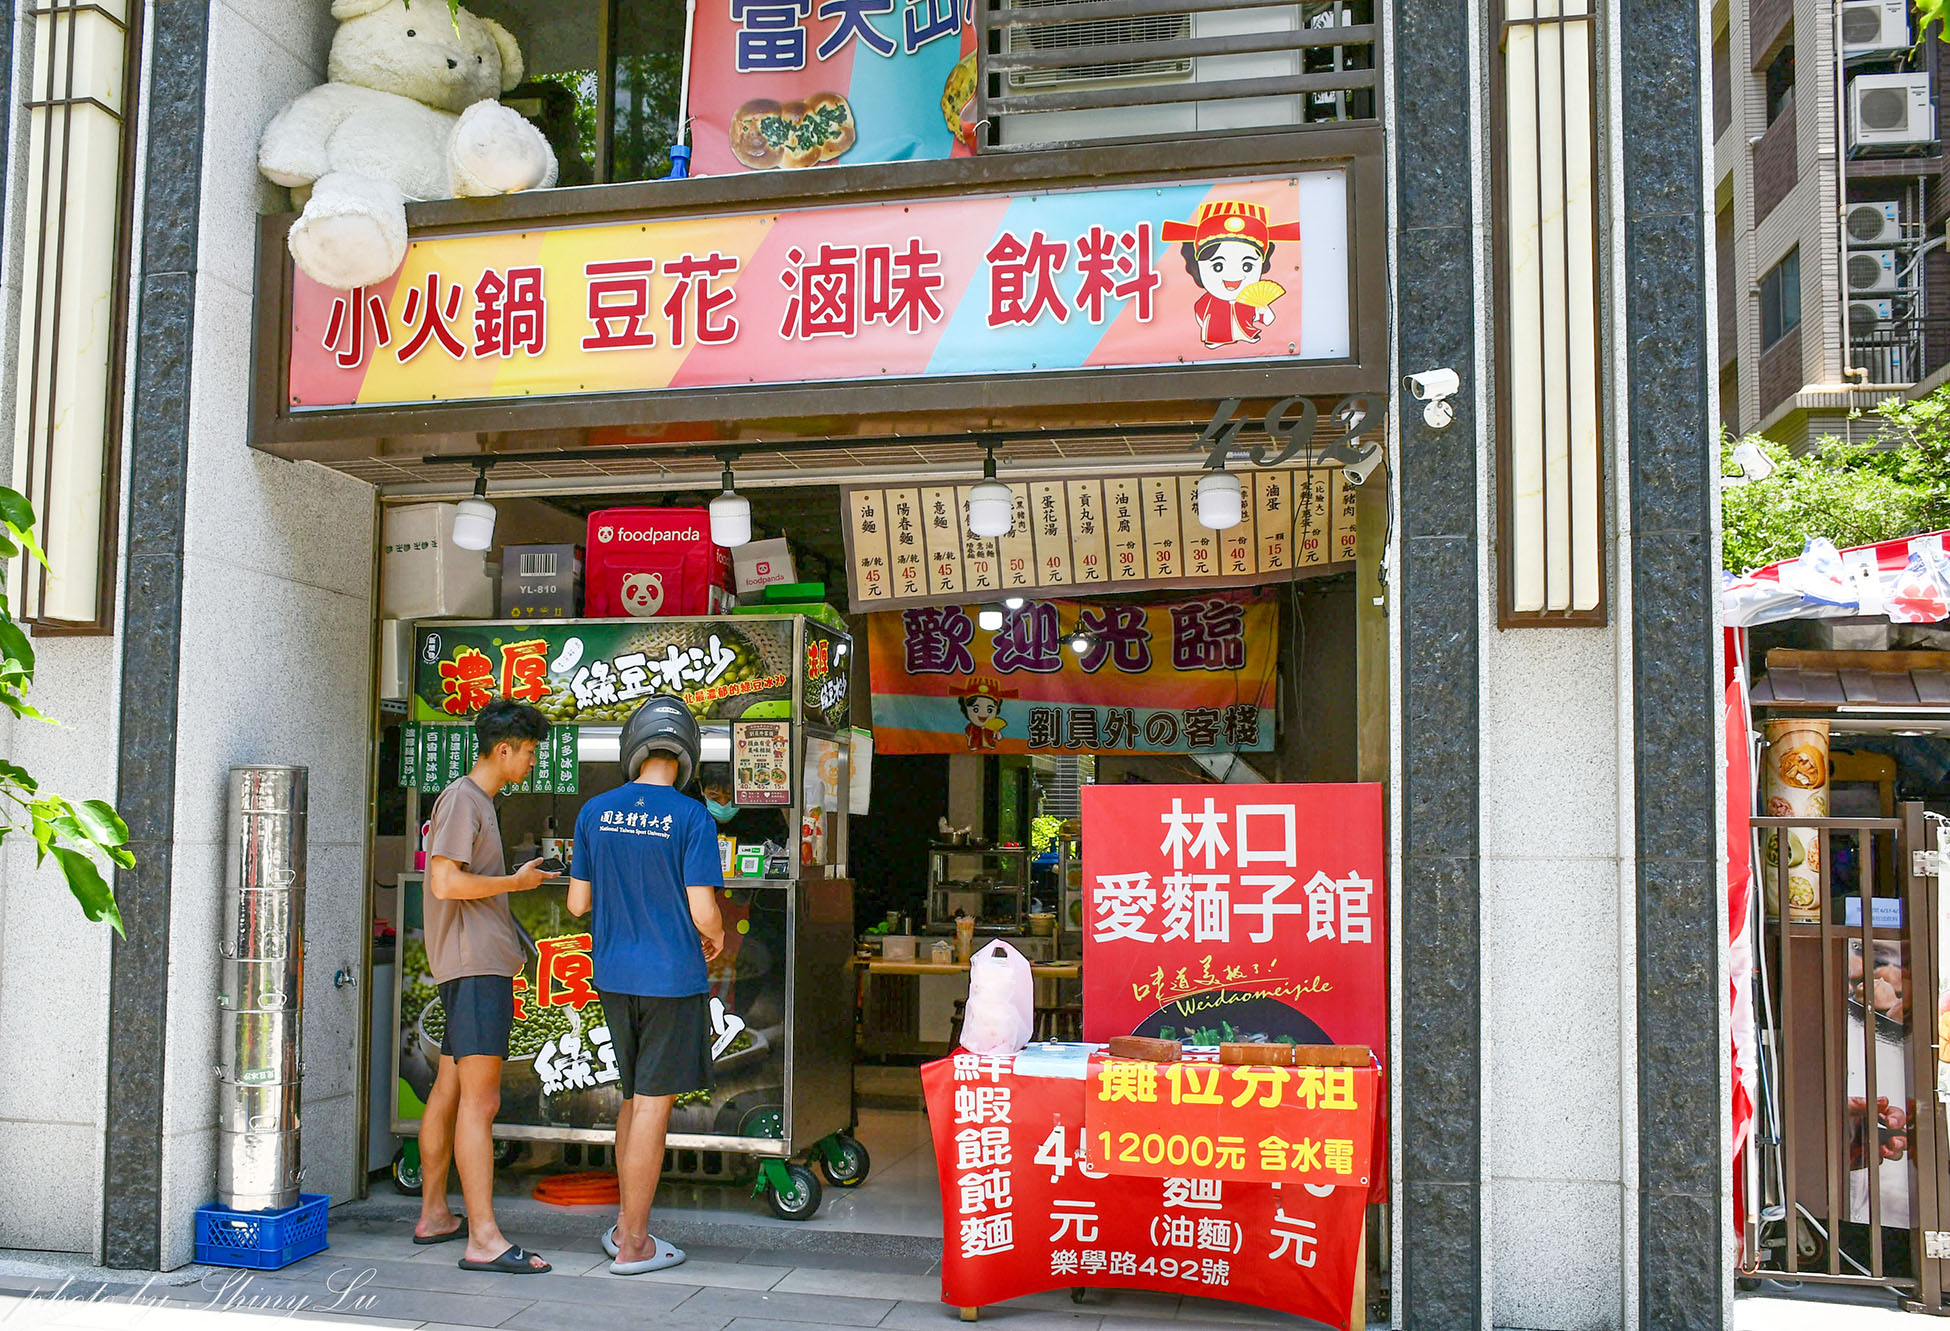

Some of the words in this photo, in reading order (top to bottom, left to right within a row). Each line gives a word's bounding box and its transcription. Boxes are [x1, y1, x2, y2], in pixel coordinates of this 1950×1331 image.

[322, 264, 547, 369] 小火鍋
[580, 250, 741, 350] 豆花
[779, 237, 943, 341] 滷味
[986, 221, 1161, 329] 飲料
[1187, 392, 1386, 469] 492
[1153, 492, 1168, 517] 豆干
[1266, 484, 1281, 512] 滷蛋
[860, 505, 877, 533] 油麵
[896, 502, 914, 545] 陽春麵
[933, 501, 948, 529] 意麵
[1041, 495, 1058, 536] 蛋花湯
[1078, 493, 1095, 535] 貢丸湯
[1115, 493, 1131, 533] 油豆腐
[618, 527, 700, 544] foodpanda
[1116, 541, 1136, 550] 一份
[1153, 539, 1173, 548] 一份
[1190, 537, 1210, 546] 一份
[1228, 536, 1248, 545] 一份
[1268, 544, 1282, 555] 15
[1304, 539, 1318, 550] 60
[1341, 535, 1355, 545] 60
[974, 561, 988, 573] 70
[1010, 559, 1025, 571] 50
[1046, 556, 1061, 568] 40
[1083, 555, 1097, 566] 40
[1119, 552, 1134, 564] 30
[1156, 551, 1171, 562] 30
[1193, 549, 1208, 560] 30
[1230, 548, 1245, 559] 40
[746, 574, 785, 586] foodpanda
[865, 570, 880, 582] 45
[902, 567, 917, 579] 45
[938, 564, 953, 576] 45
[520, 585, 557, 594] YL-810
[902, 600, 1246, 675] 歡迎光臨
[438, 639, 553, 715] 濃厚
[569, 634, 737, 711] 綠豆冰沙
[1027, 705, 1260, 750] 劉員外の客棧
[425, 732, 439, 782] 百香果冰沙
[538, 733, 550, 779] 豆沙牛奶
[560, 732, 573, 781] 多多冰沙
[1161, 798, 1297, 870] 林口
[1093, 870, 1374, 945] 愛麵子館
[1175, 976, 1333, 1017] Weidaomeijile
[1098, 1060, 1358, 1110] 攤位分租
[953, 1053, 1015, 1259] 鮮蝦餛飩麵
[1098, 1131, 1246, 1170] 12000元
[1259, 1136, 1354, 1175] 含水電
[1049, 1200, 1099, 1243] 元
[1150, 1214, 1243, 1255] (油麵)
[1269, 1212, 1318, 1268] 元
[1050, 1249, 1231, 1286] 樂學路492號
